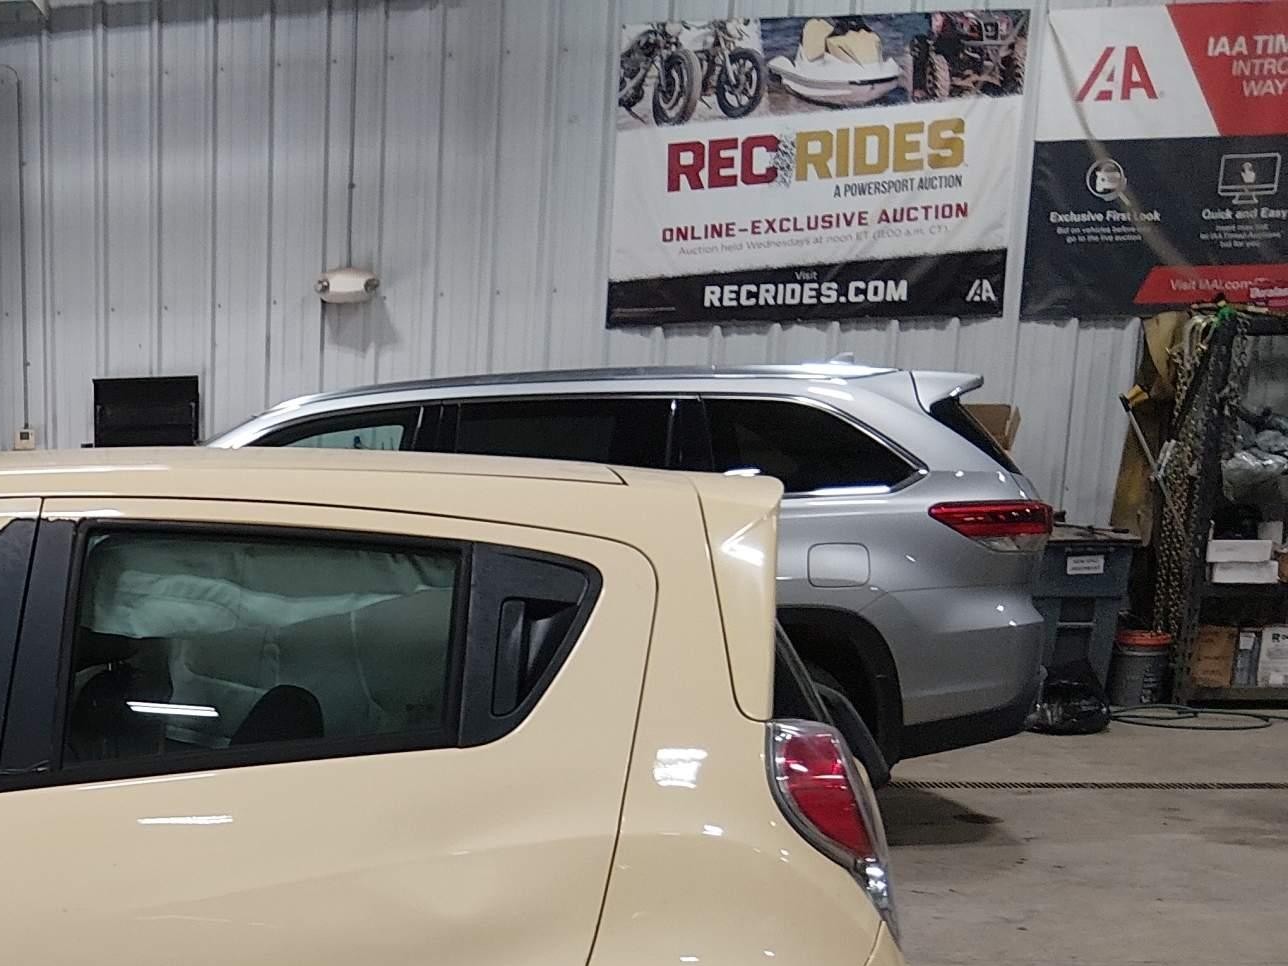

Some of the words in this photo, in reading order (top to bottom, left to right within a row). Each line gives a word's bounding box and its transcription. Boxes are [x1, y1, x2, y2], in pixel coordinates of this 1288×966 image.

[1207, 35, 1249, 57] IAA
[667, 134, 780, 192] REC
[795, 118, 965, 182] RIDES
[833, 184, 841, 198] A
[843, 177, 916, 198] POWERSPORT
[917, 174, 963, 192] AUCTION
[662, 210, 869, 243] ONLINE-EXCLUSIVE
[877, 201, 969, 225] AUCTION
[678, 243, 719, 256] Auction
[720, 241, 743, 253] held
[746, 236, 810, 251] Wednesdays
[795, 271, 818, 281] Visit
[703, 279, 908, 308] RECRIDES.COM
